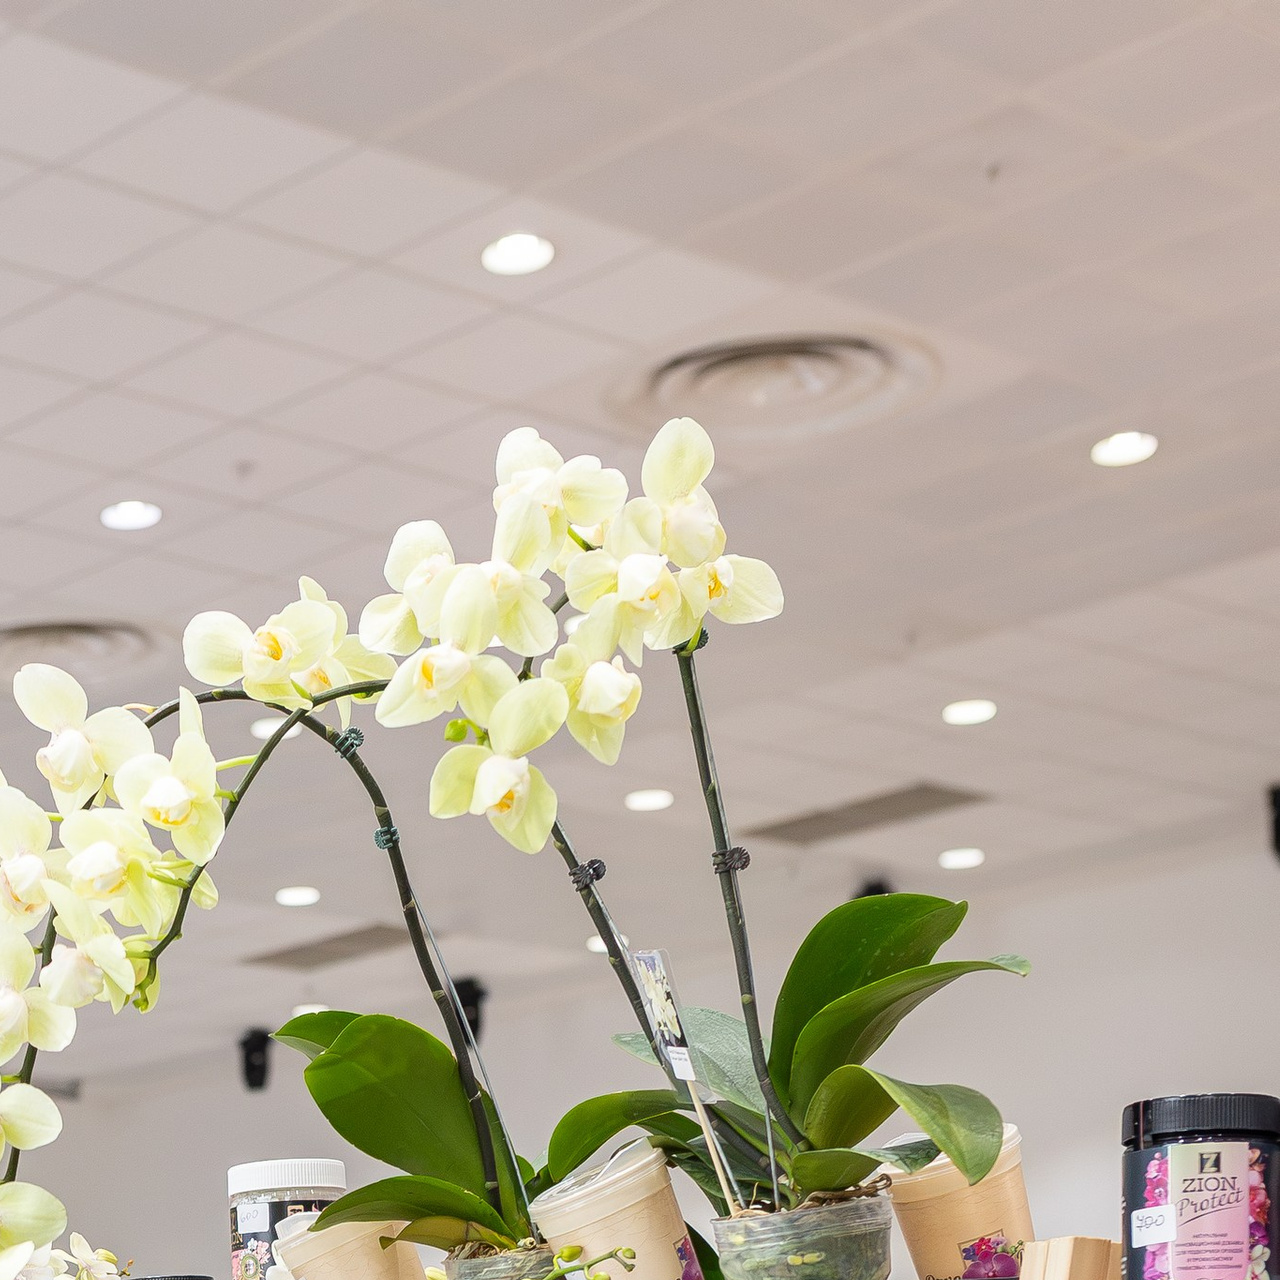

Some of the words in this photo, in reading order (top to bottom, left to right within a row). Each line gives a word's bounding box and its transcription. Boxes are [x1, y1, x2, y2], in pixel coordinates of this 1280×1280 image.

[1182, 1176, 1237, 1193] ZION
[1176, 1189, 1245, 1217] Protect
[1135, 1213, 1165, 1232] 700
